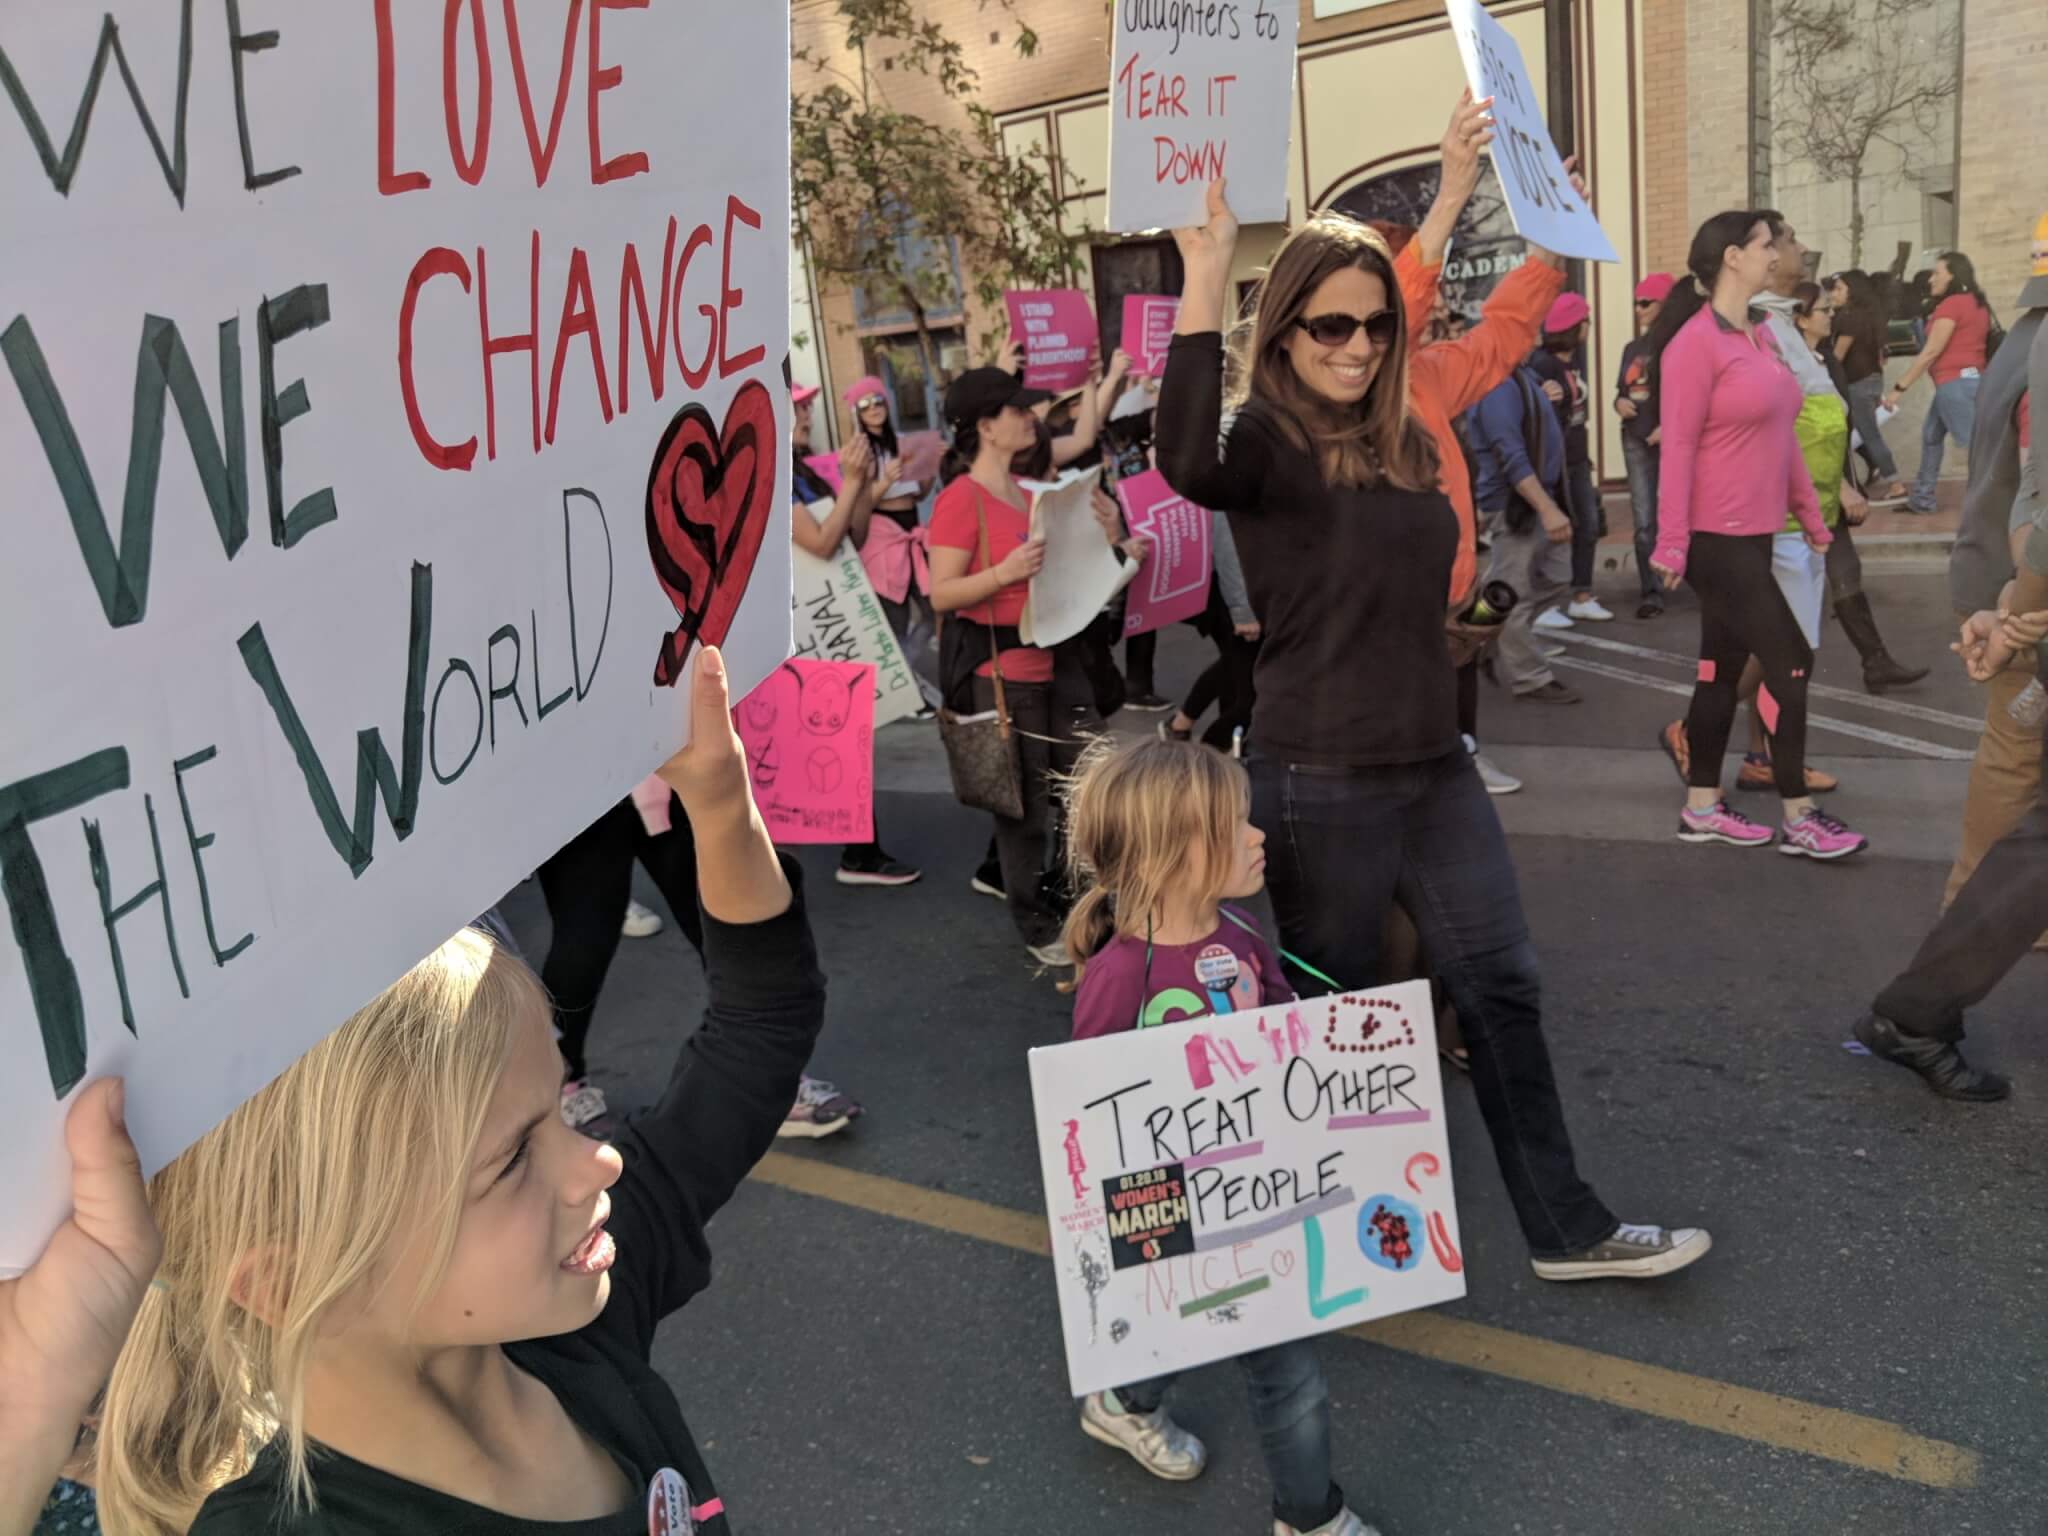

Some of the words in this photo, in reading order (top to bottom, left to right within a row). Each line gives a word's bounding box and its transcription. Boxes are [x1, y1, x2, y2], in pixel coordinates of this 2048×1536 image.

[1255, 0, 1279, 40] to
[0, 0, 302, 210] WE
[374, 0, 650, 196] LOVE
[1118, 53, 1189, 119] TEAR
[1207, 75, 1237, 117] IT
[1153, 136, 1227, 184] DOWN
[1445, 253, 1526, 280] CADEM
[0, 283, 338, 628] WE
[398, 195, 765, 471] CHANGE
[805, 579, 861, 663] RAYAL
[0, 745, 258, 1099] THE
[236, 487, 613, 879] WORLD
[1084, 1079, 1262, 1168] TREAT
[1284, 1055, 1423, 1122] OTHER
[1107, 1196, 1190, 1239] MARCH
[1111, 1180, 1181, 1211] WOMEN'S
[1188, 1151, 1345, 1226] PEOPLE
[1144, 1240, 1264, 1316] NICE
